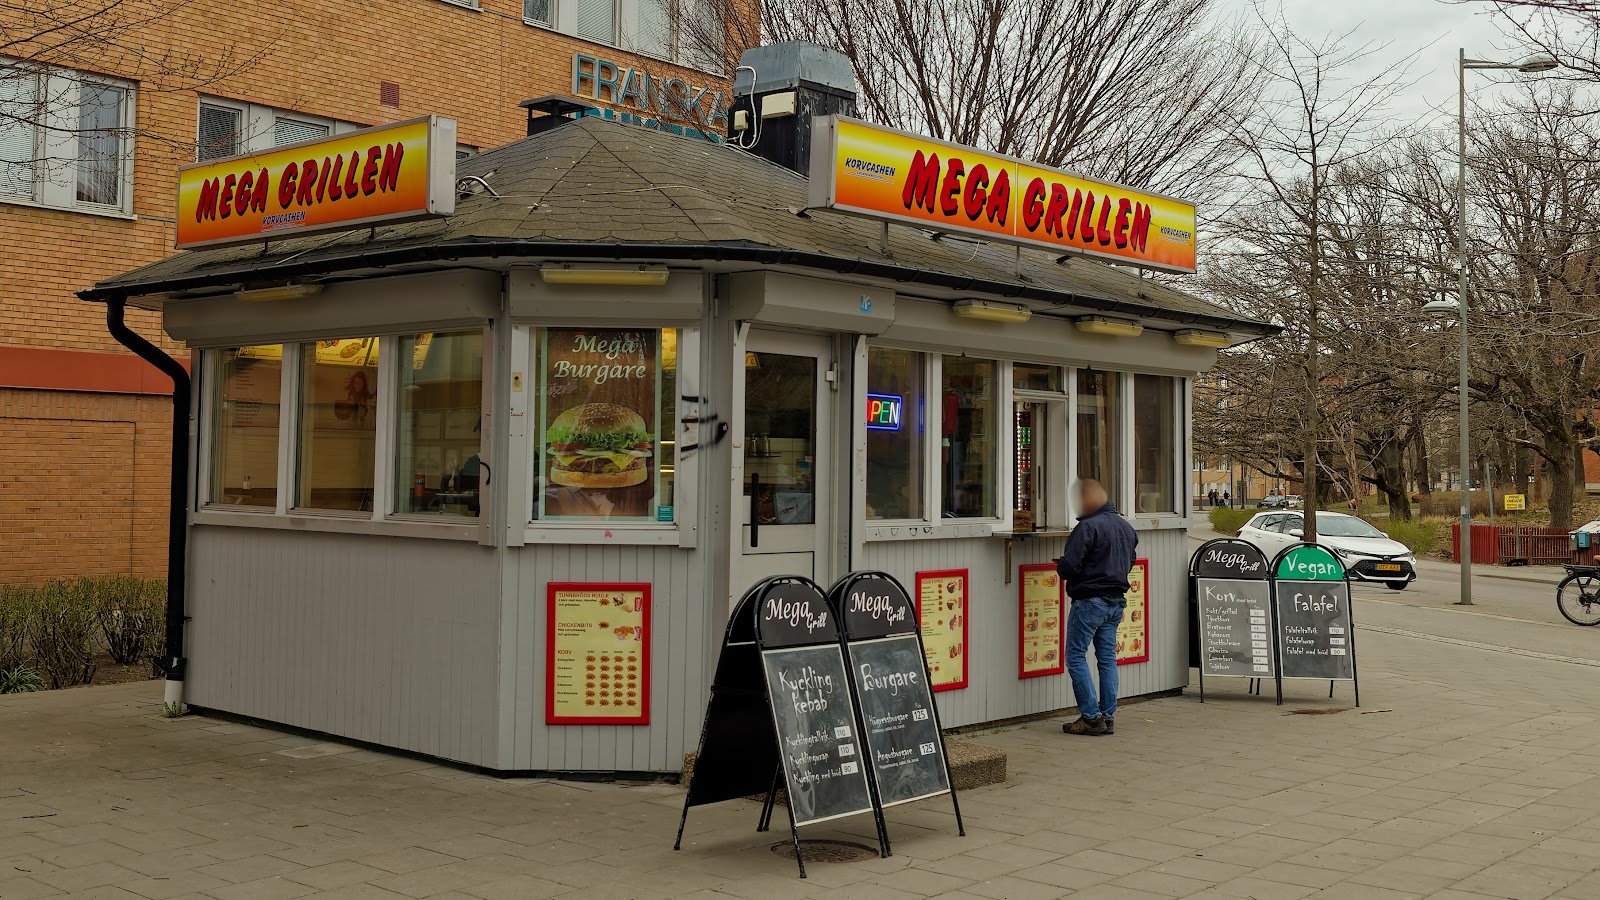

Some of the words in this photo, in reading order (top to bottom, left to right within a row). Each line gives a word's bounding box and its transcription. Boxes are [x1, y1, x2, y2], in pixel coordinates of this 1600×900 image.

[572, 54, 728, 126] FRANSKA
[845, 157, 896, 177] KORVCASHEN
[195, 166, 269, 223] MEGA
[277, 141, 404, 209] GRILLEN
[902, 149, 1011, 227] MEGA
[1022, 177, 1151, 254] GRILLEN
[262, 210, 307, 226] KORVCASHEN
[1160, 226, 1192, 240] KORVCASHEN
[571, 334, 636, 360] Mega
[553, 360, 647, 385] Burgare
[1204, 549, 1246, 568] Mega
[1240, 561, 1260, 574] Grill
[1285, 553, 1337, 580] Vegan
[1205, 585, 1236, 602] Korv
[1294, 592, 1338, 615] Falafel
[765, 598, 809, 627] Mega
[806, 611, 828, 634] Grill
[850, 592, 890, 619] Mega
[886, 606, 906, 626] Grill
[1286, 646, 1304, 655] Falafel
[778, 665, 833, 699] Kyckling
[860, 663, 917, 696] Burgare
[791, 689, 828, 717] kebab
[914, 710, 926, 720] 125
[786, 730, 830, 750] Kycklingtallrik
[836, 729, 846, 737] 110
[789, 751, 829, 768] Kycklingwrap
[840, 746, 850, 754] 110
[921, 744, 933, 754] 125
[793, 769, 820, 787] Kyckling
[843, 765, 852, 773] 90
